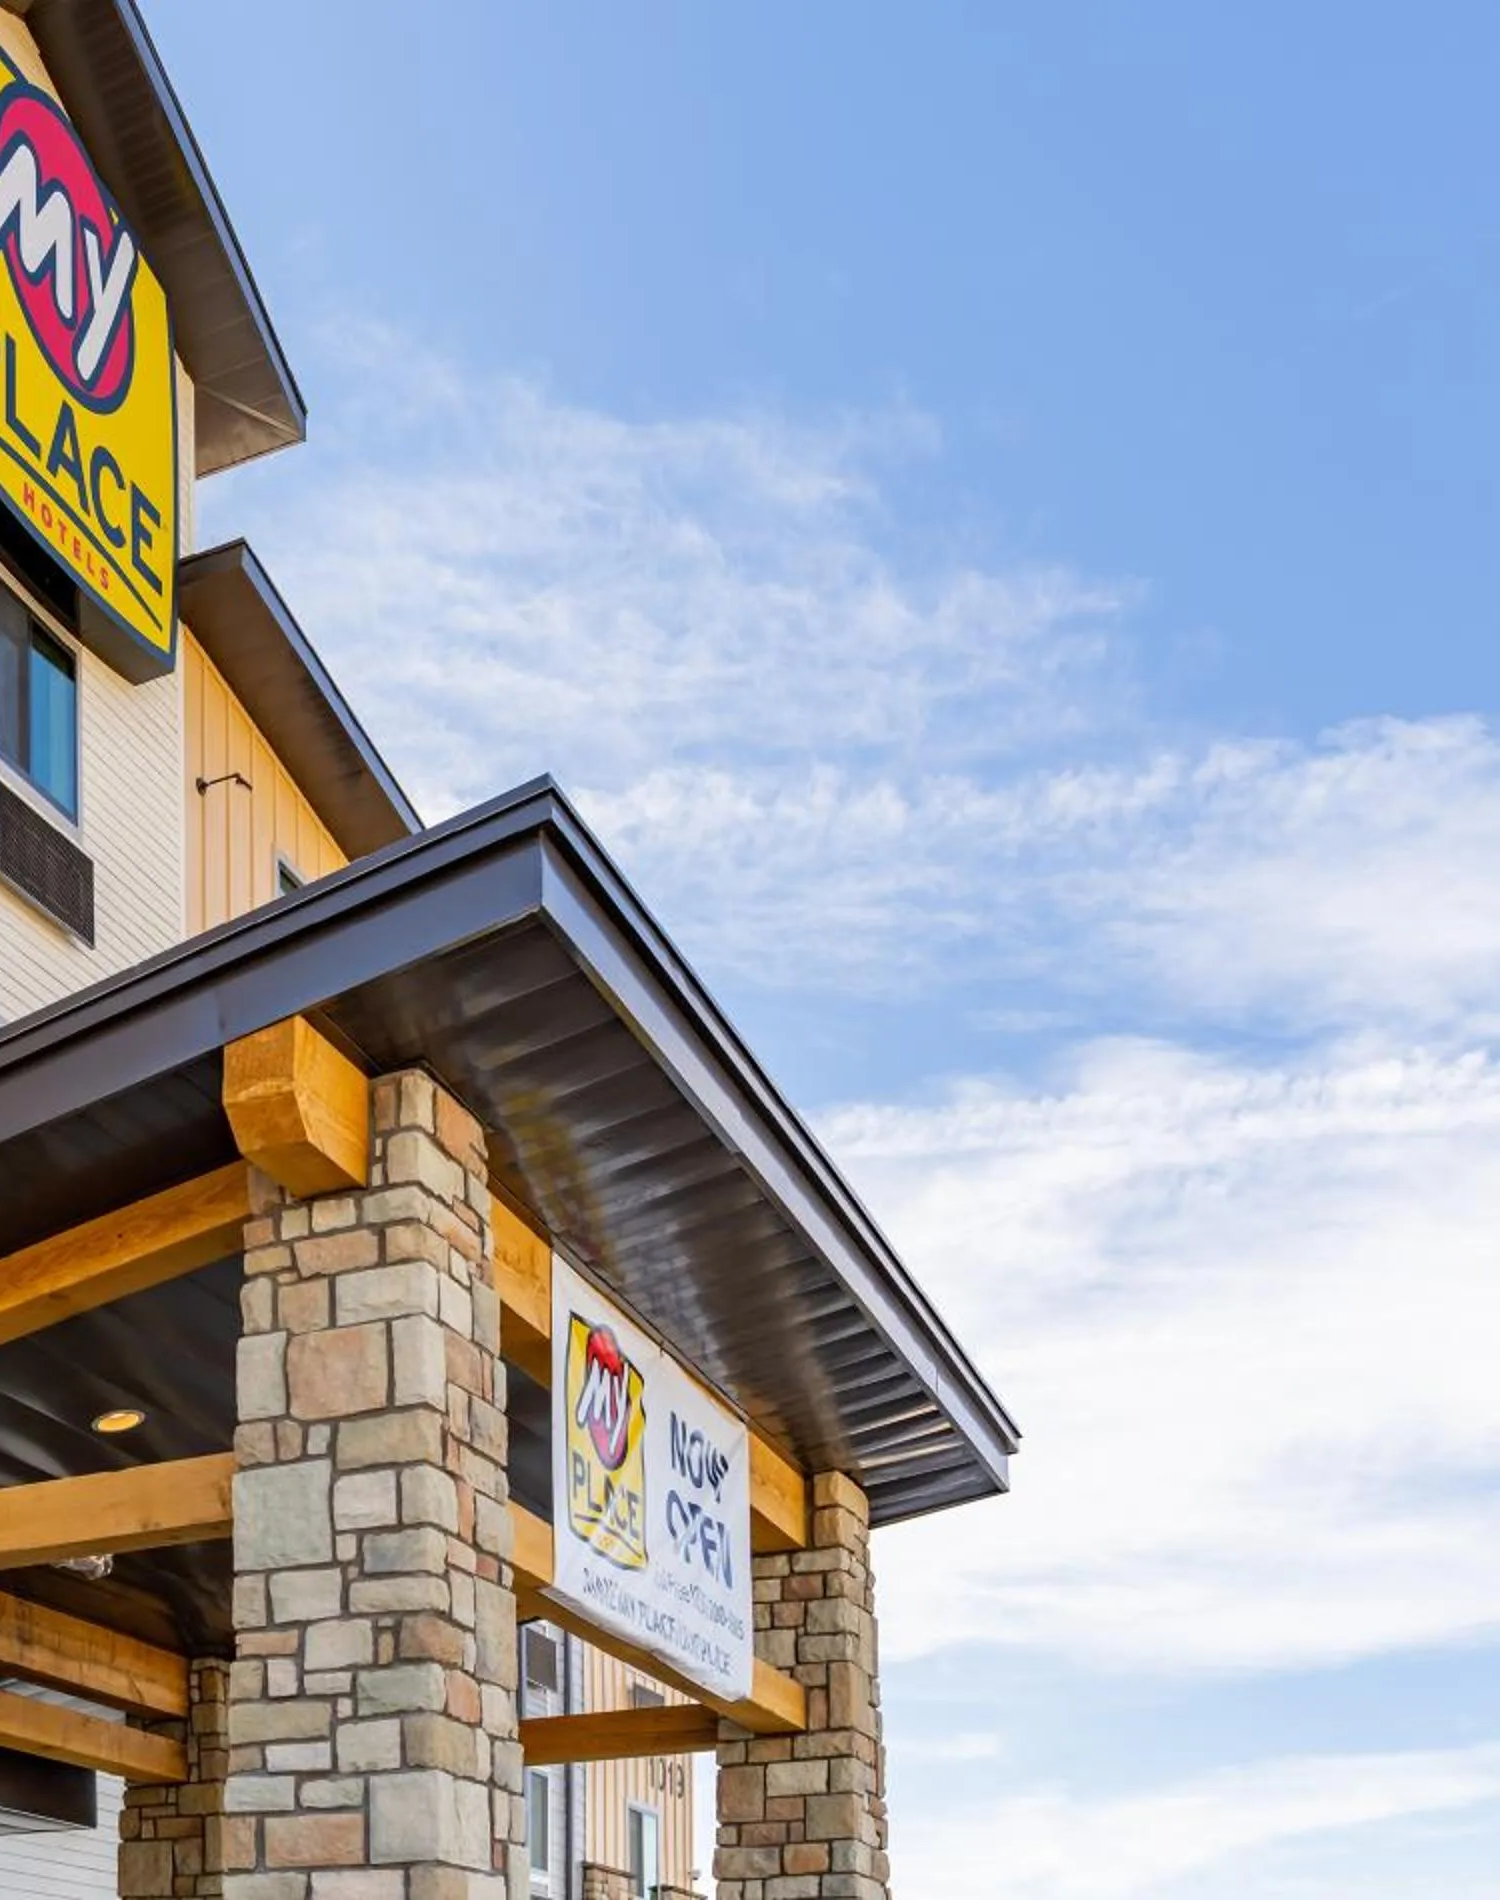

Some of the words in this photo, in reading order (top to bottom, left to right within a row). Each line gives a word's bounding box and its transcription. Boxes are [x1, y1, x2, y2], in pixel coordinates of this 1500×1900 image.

[22, 482, 111, 591] HOTELS
[572, 1449, 640, 1540] PLACE
[670, 1409, 729, 1504] NOW
[666, 1490, 733, 1590] OPEN
